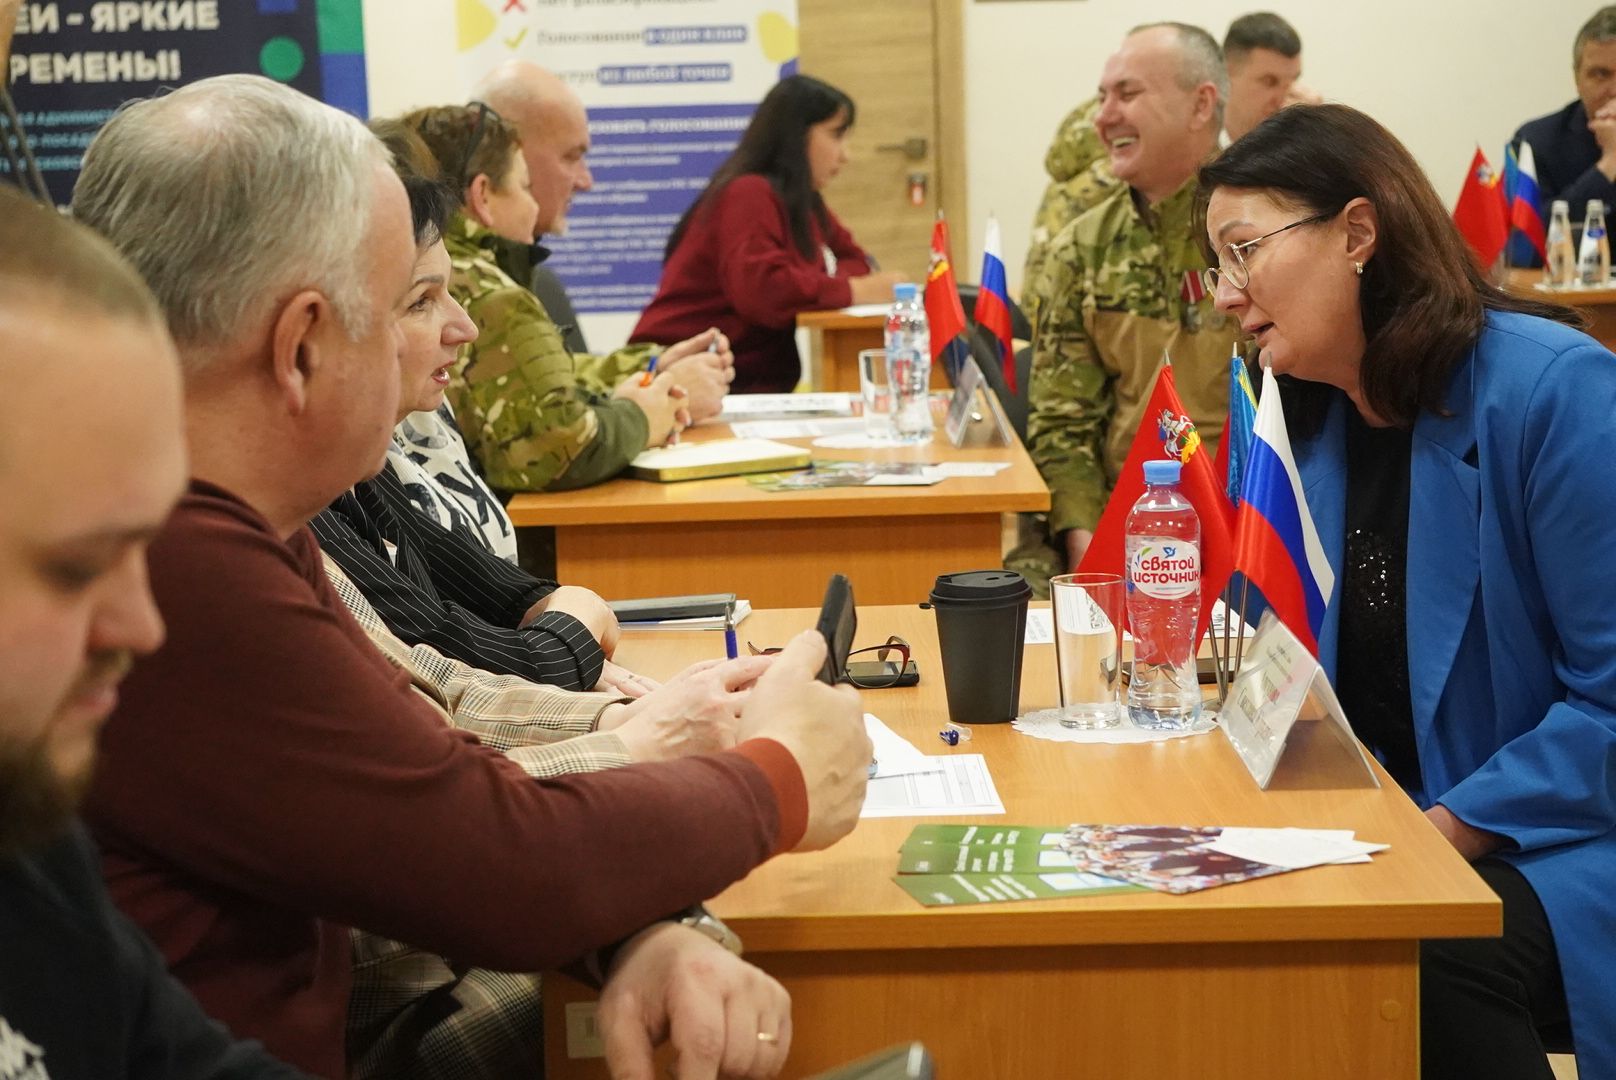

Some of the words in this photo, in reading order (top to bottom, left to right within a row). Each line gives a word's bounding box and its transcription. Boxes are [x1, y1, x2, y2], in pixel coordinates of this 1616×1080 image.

[90, 0, 220, 33] ЯРКИЕ
[10, 49, 182, 84] РЕМЕНЫ!
[1141, 556, 1194, 571] СВЯТОЙ
[1134, 571, 1199, 584] ИСТОЧНИК
